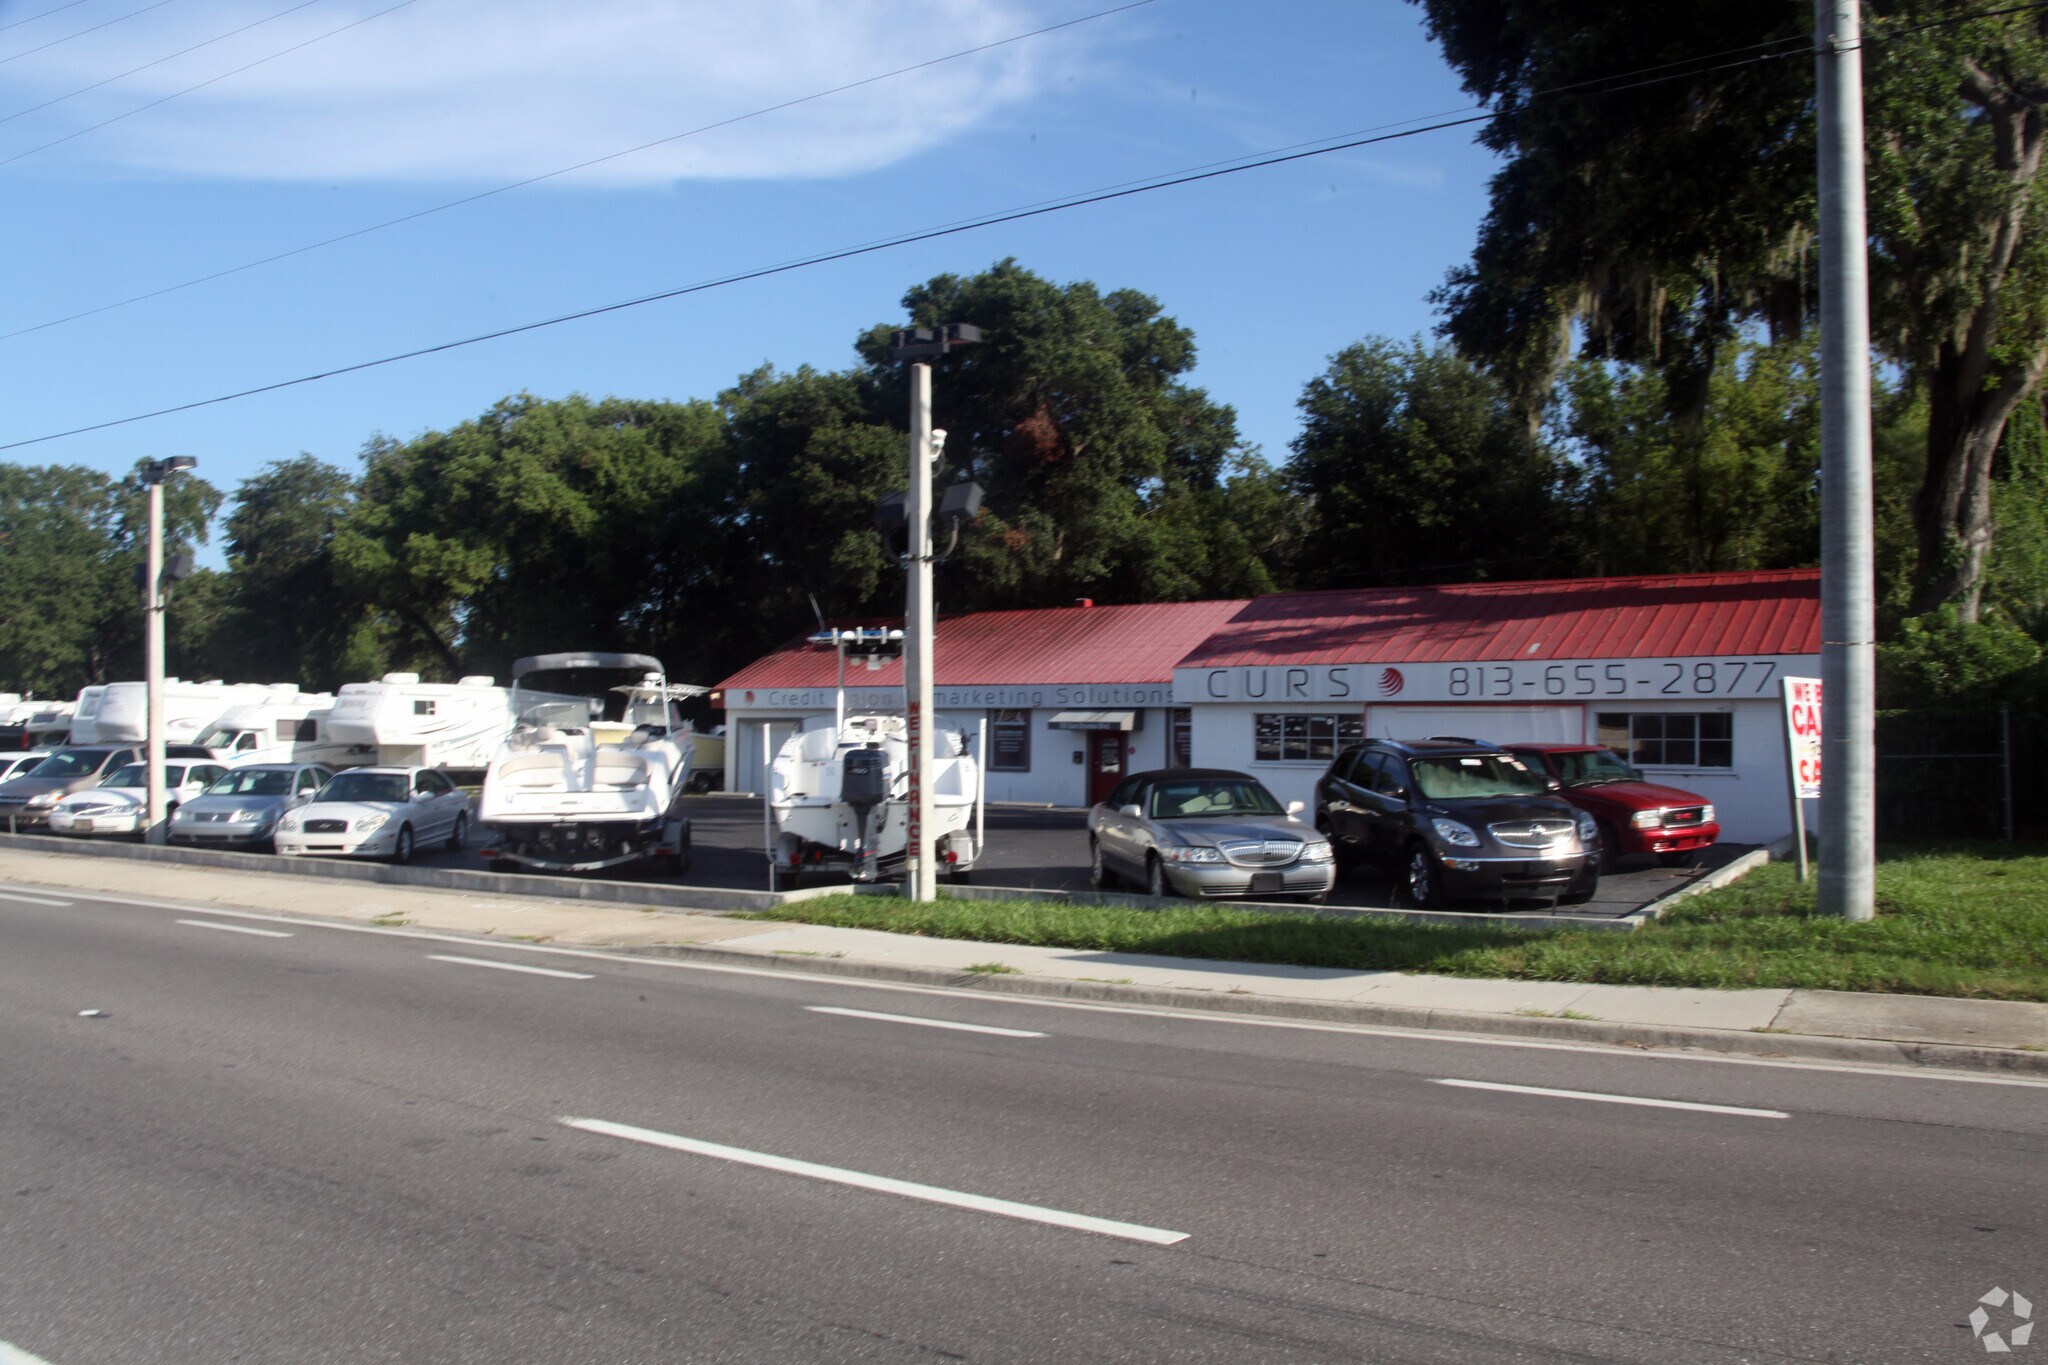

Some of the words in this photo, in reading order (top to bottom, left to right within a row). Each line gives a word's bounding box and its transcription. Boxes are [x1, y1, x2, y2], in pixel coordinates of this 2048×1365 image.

[769, 691, 825, 706] Credit
[846, 691, 895, 706] nion
[933, 686, 1043, 707] marketing
[1056, 687, 1169, 704] Solutions
[1207, 668, 1350, 698] CURS
[1448, 662, 1777, 696] 813-655-2877
[909, 701, 921, 731] WE
[909, 737, 921, 856] FINANCE
